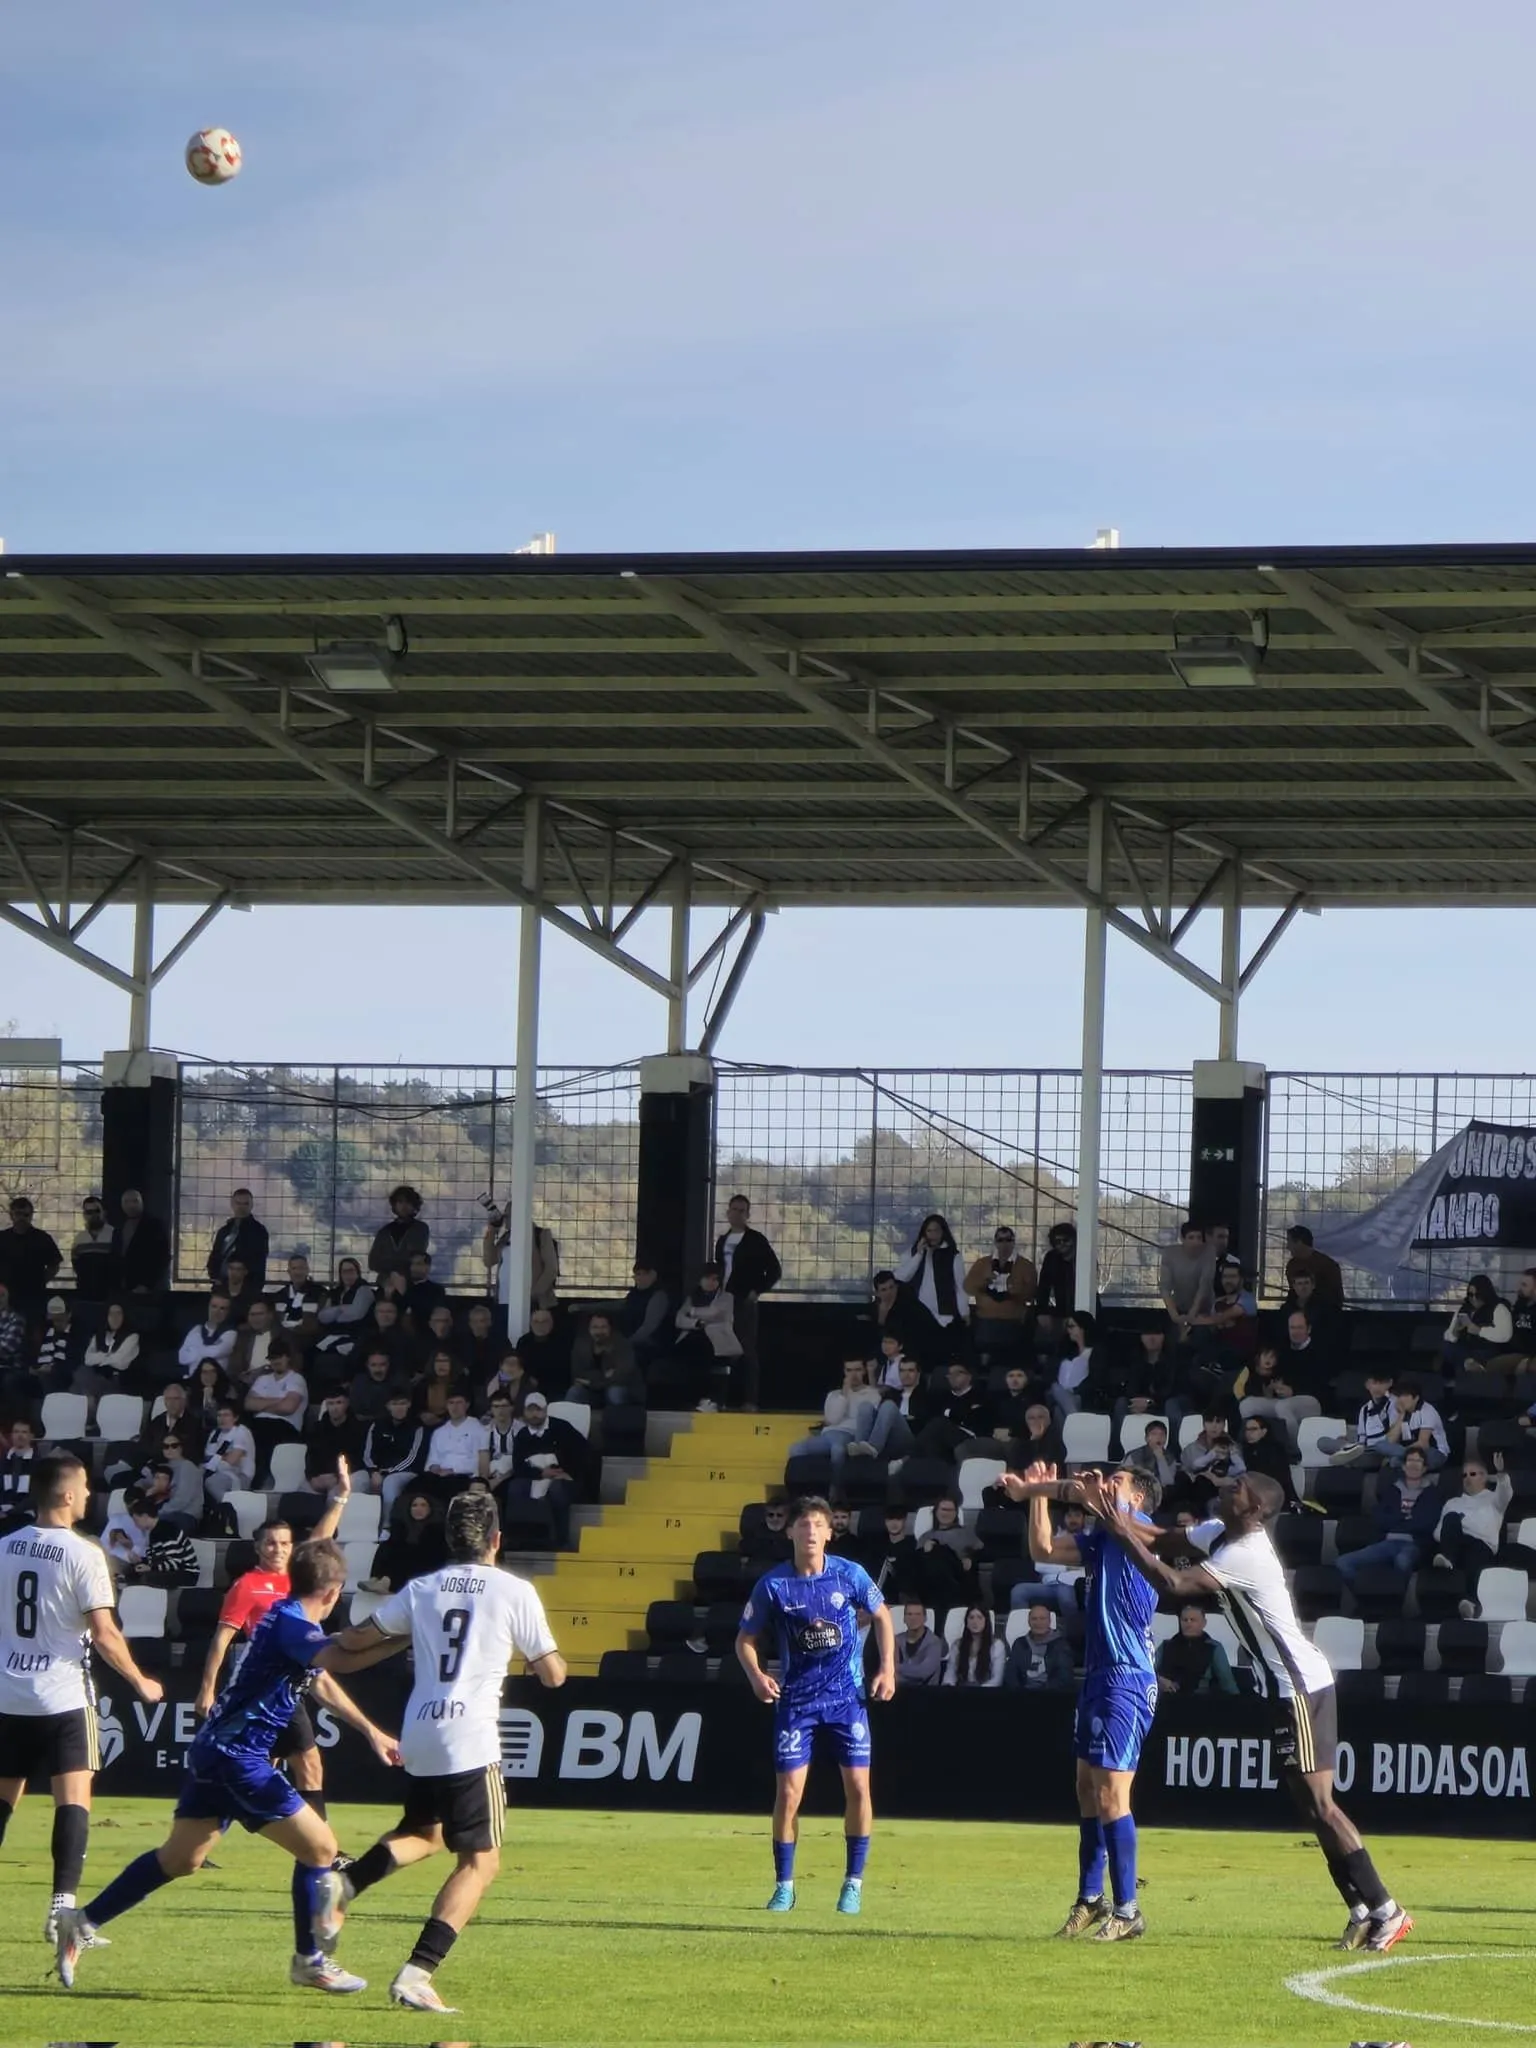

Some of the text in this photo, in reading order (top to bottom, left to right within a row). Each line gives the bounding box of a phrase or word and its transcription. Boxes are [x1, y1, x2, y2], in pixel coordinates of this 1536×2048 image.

[16, 1570, 39, 1639] 8
[439, 1608, 471, 1683] 3
[558, 1709, 702, 1782] BM
[778, 1728, 802, 1753] 22
[1165, 1736, 1279, 1790] HOTEL
[1372, 1743, 1530, 1798] BIDASOA
